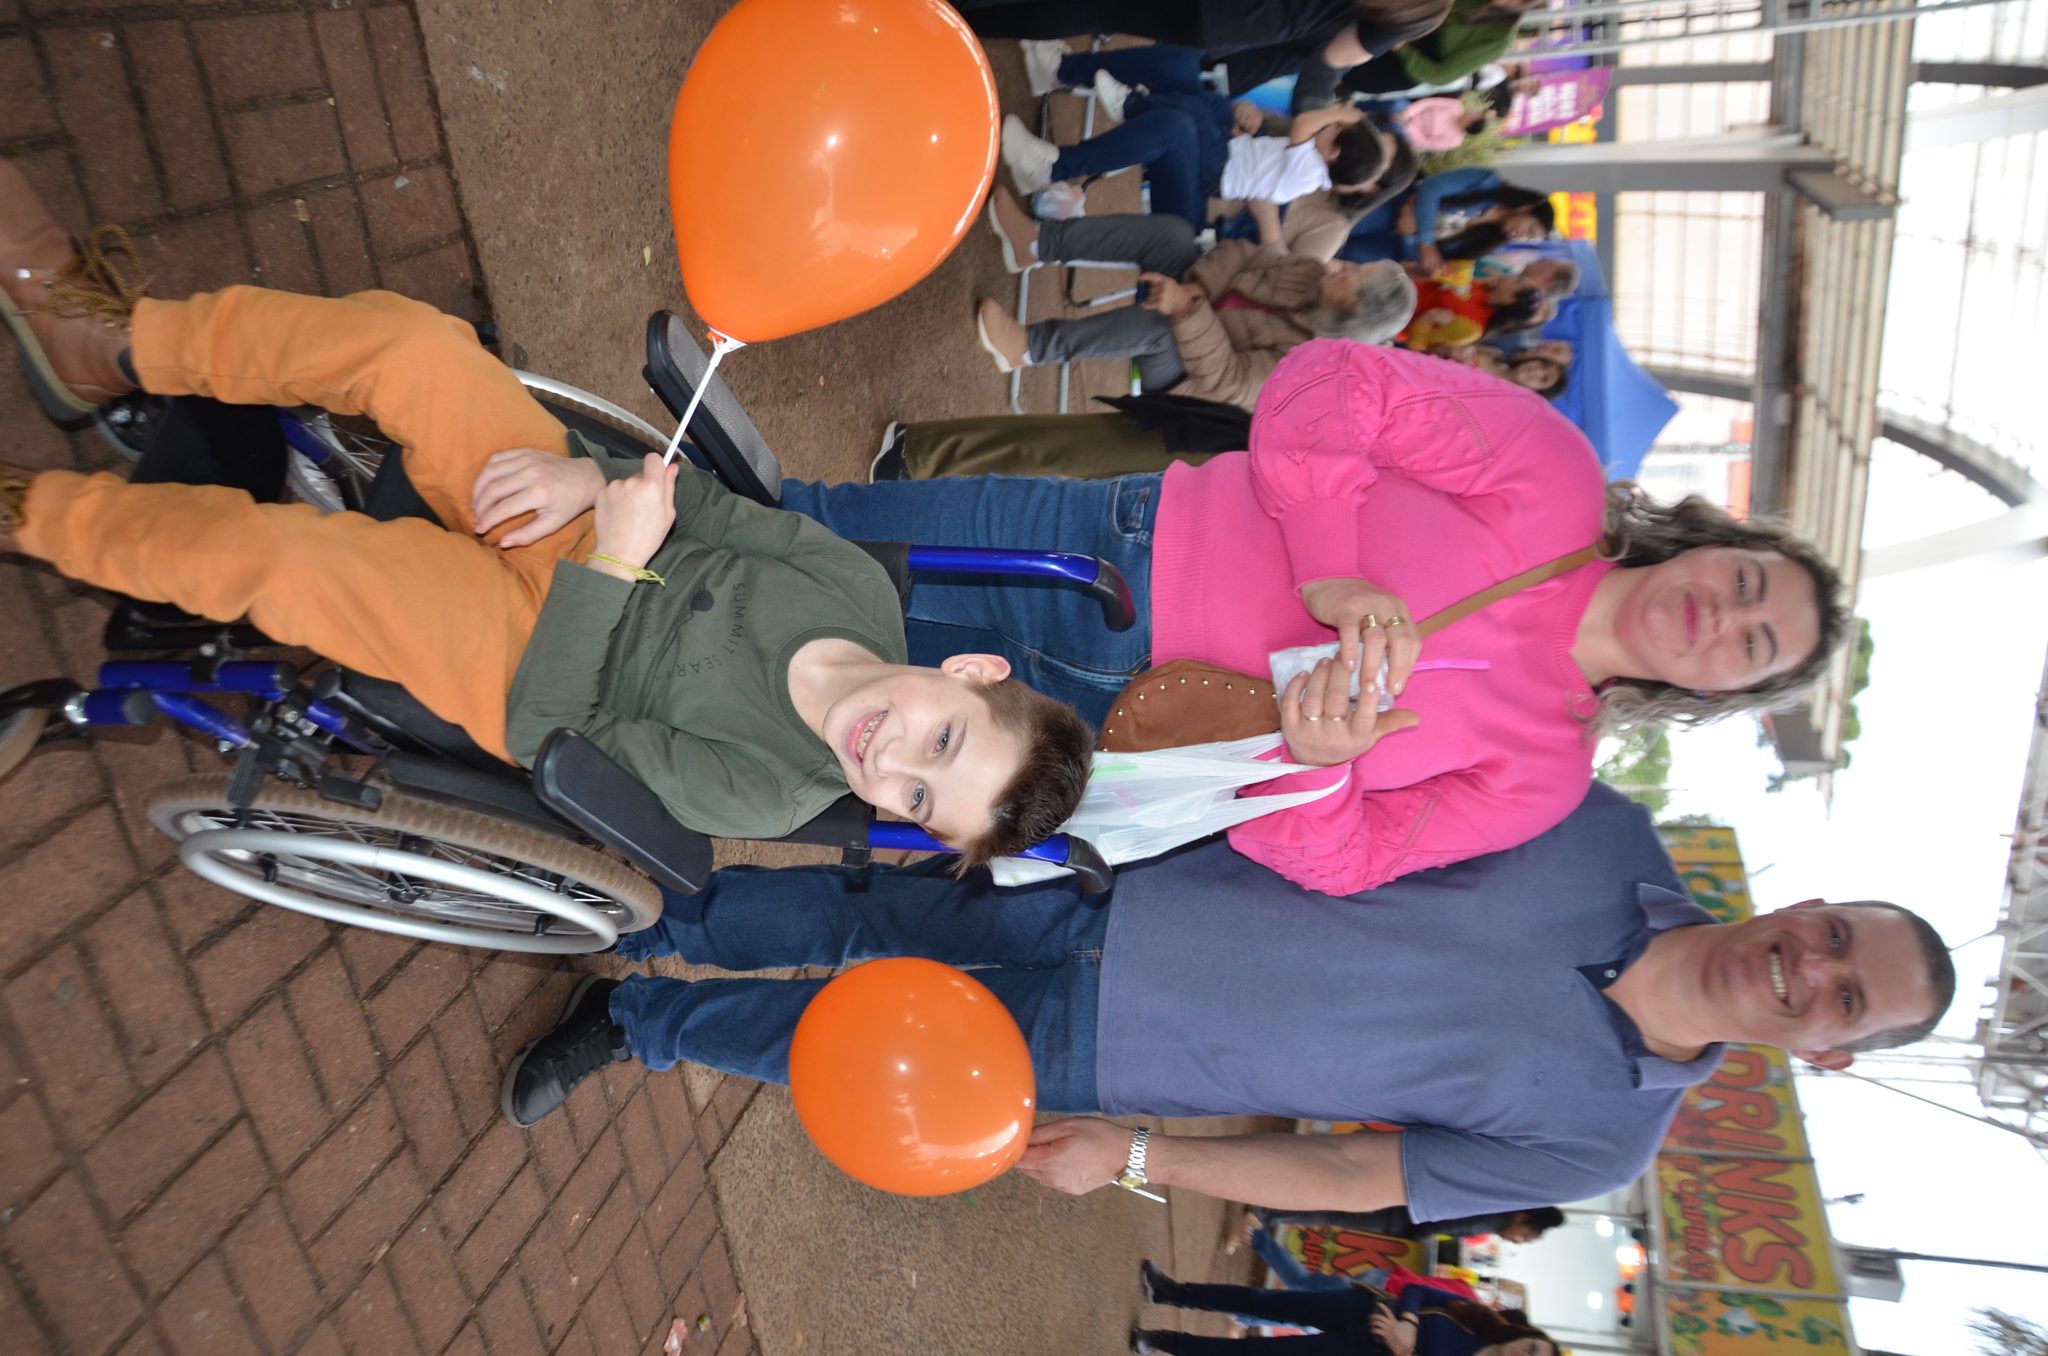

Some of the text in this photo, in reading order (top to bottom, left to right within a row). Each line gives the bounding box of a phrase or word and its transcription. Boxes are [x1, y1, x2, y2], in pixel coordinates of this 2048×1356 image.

[722, 583, 747, 656] SUMMIT
[1698, 1049, 1816, 1290] DRINKS
[1679, 1179, 1718, 1282] CAIPIRAS
